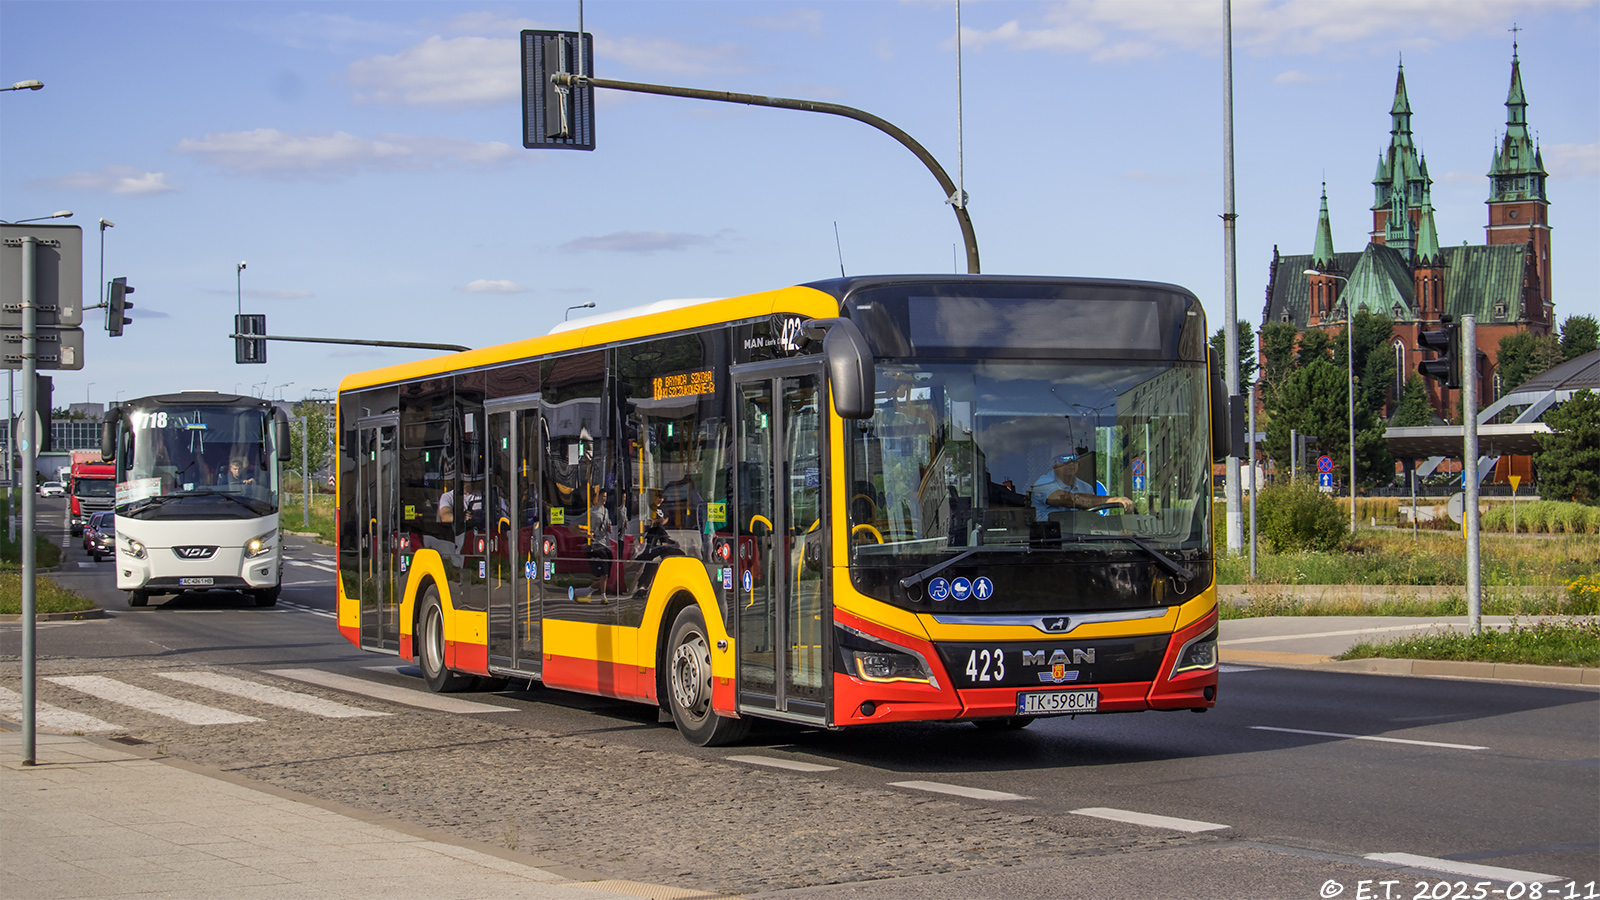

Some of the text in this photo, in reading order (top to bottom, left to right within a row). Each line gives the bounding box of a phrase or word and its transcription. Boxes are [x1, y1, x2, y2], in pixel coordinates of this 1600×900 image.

[744, 337, 764, 349] MAN
[781, 317, 804, 351] 423
[652, 377, 663, 401] 18
[179, 548, 211, 557] VDL
[966, 649, 1005, 682] 423
[1022, 648, 1096, 666] MAN
[1029, 692, 1095, 710] TK 598CM
